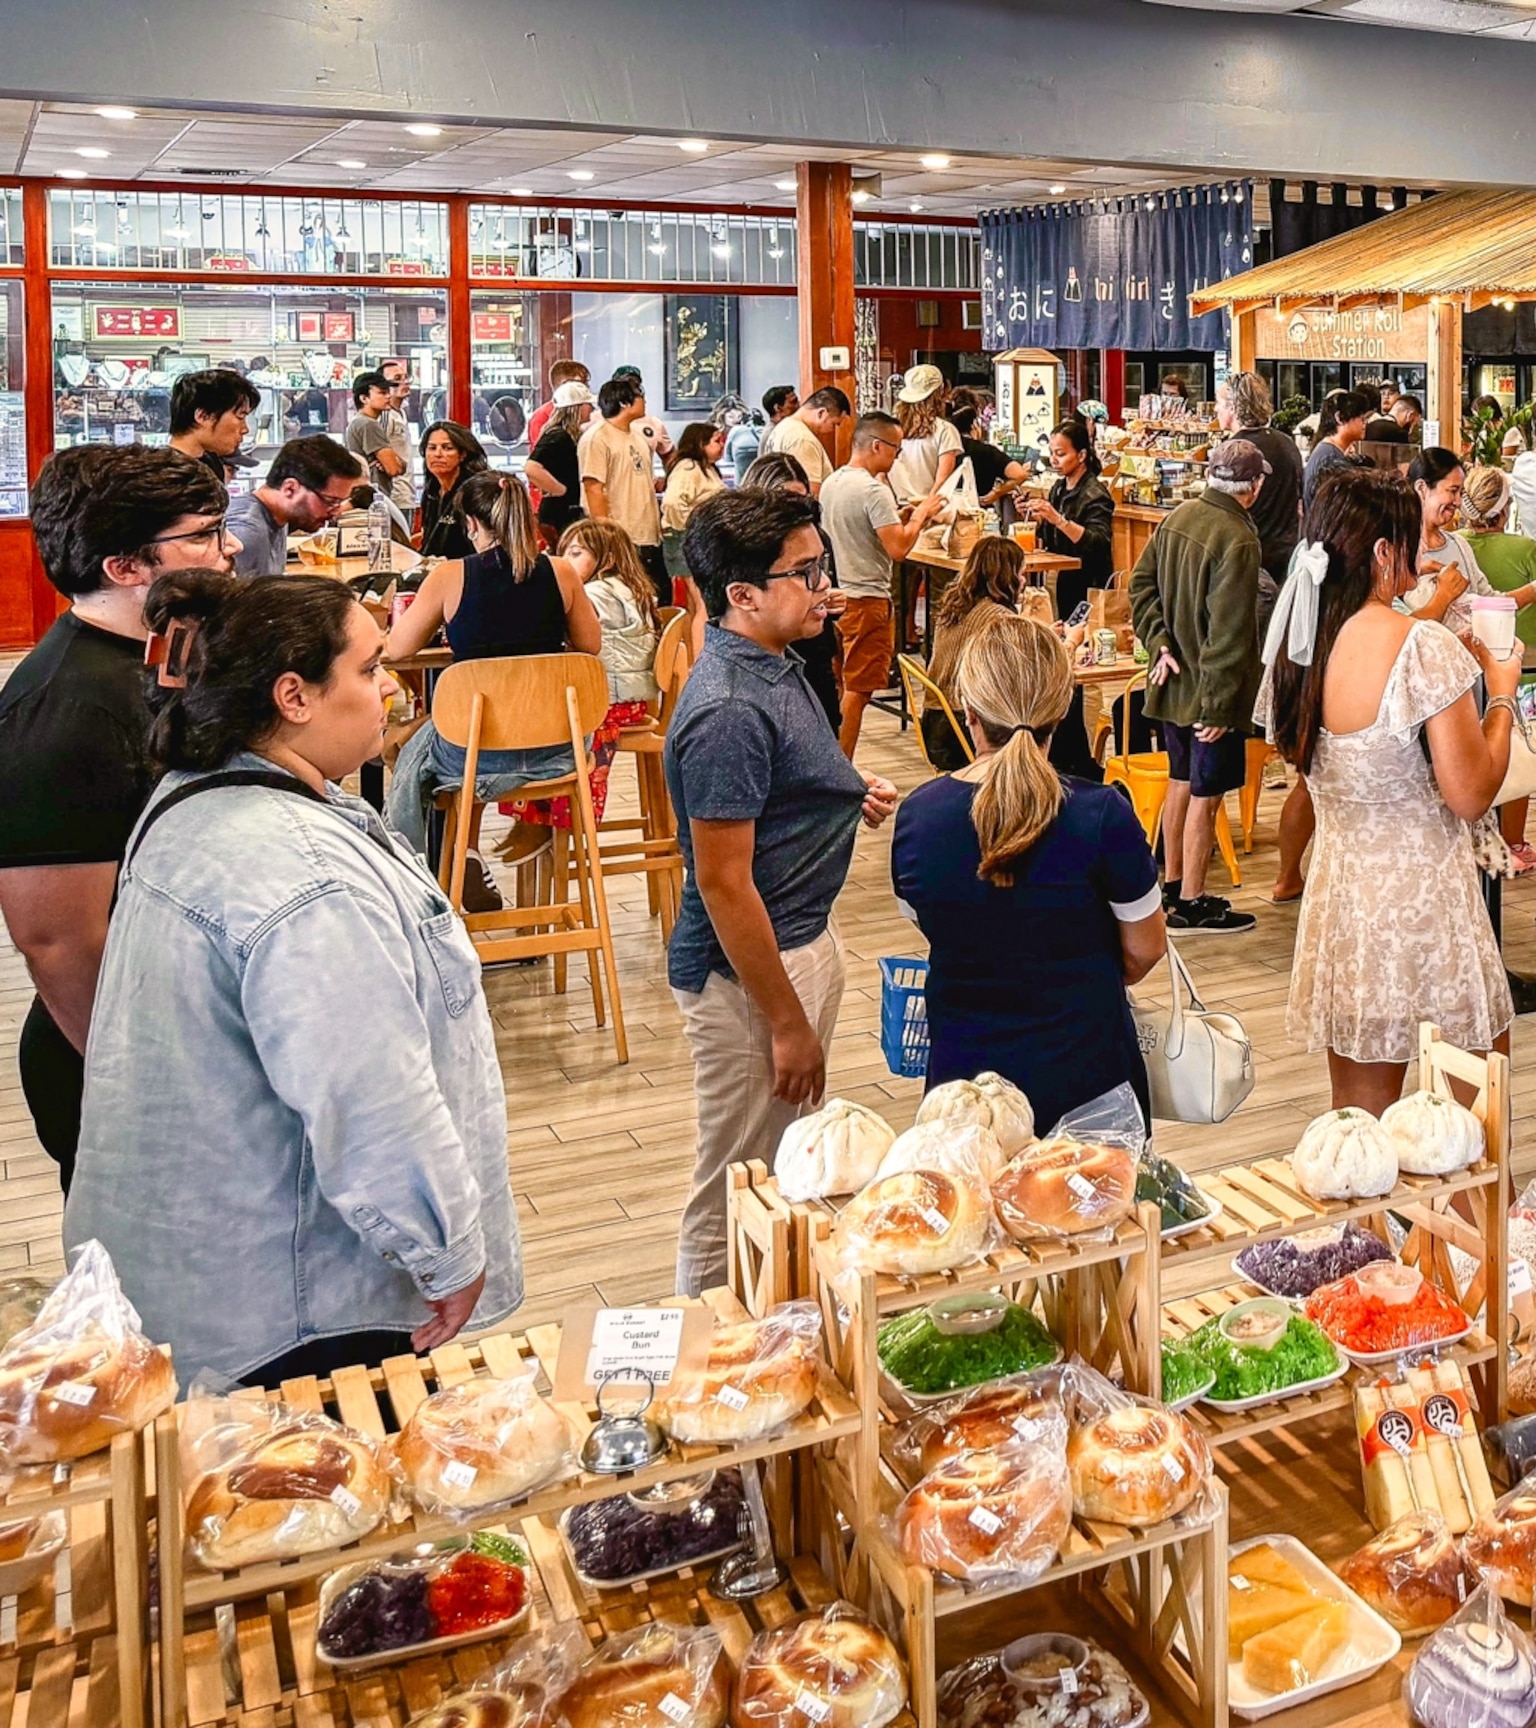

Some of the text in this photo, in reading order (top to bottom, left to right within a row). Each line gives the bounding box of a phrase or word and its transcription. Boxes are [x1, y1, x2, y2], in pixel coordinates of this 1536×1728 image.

[1008, 284, 1055, 321] おに
[1312, 310, 1403, 332] Summer Roll
[1332, 335, 1386, 357] Station
[623, 1330, 660, 1340] Custard
[631, 1341, 651, 1350] Bun
[593, 1369, 619, 1380] GET
[635, 1370, 671, 1381] FREE
